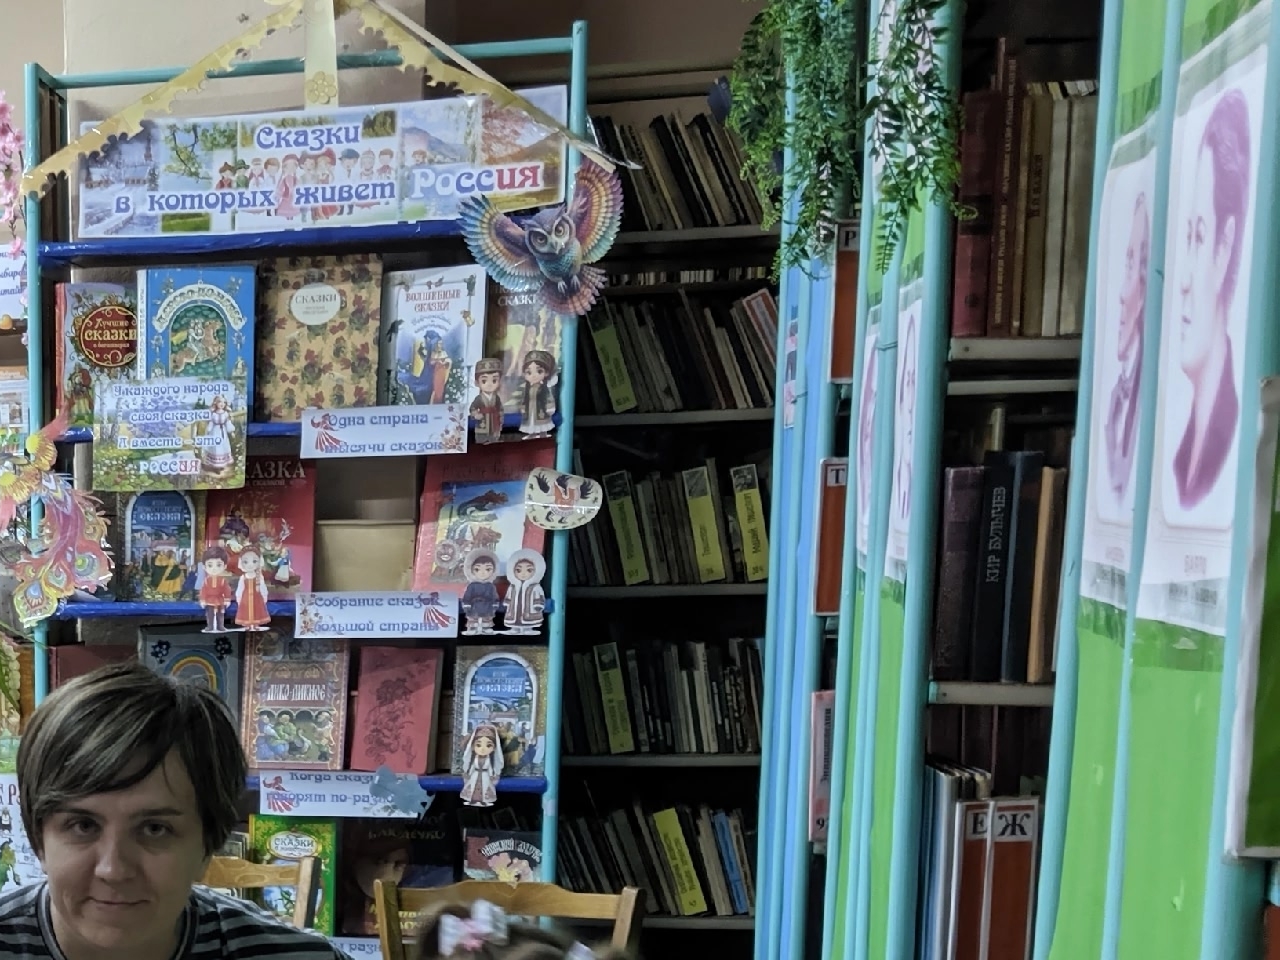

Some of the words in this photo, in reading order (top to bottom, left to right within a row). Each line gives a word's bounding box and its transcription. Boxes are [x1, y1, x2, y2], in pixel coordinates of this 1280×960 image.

[256, 124, 361, 151] Сказки
[115, 195, 131, 213] в
[148, 190, 276, 214] которых
[294, 180, 396, 205] живет
[411, 164, 541, 199] Россия
[295, 293, 338, 304] СКАЗКИ
[405, 289, 461, 302] ВОЛШЕБНЫЕ
[414, 301, 449, 312] СКАЗКИ
[95, 318, 128, 329] Лучшие
[84, 328, 137, 341] сказки
[124, 384, 180, 397] каждого
[184, 384, 229, 397] народа
[130, 411, 159, 422] своя
[165, 410, 210, 422] сказка
[328, 414, 365, 429] Одна
[370, 413, 429, 429] страна
[131, 438, 181, 447] вместе
[195, 436, 222, 446] это
[325, 442, 385, 453] тысячи
[390, 441, 442, 453] сказок
[246, 460, 307, 479] АЗКА
[830, 468, 845, 484] Т
[989, 486, 1007, 551] БУЛЫЧЕВ
[986, 555, 1000, 583] КИР
[315, 595, 383, 609] Собрание
[314, 620, 375, 633] большой
[379, 621, 440, 633] страны
[289, 772, 331, 783] Когда
[267, 792, 326, 804] говорят
[998, 813, 1031, 837] Ж
[274, 838, 314, 847] СКАЗКИ
